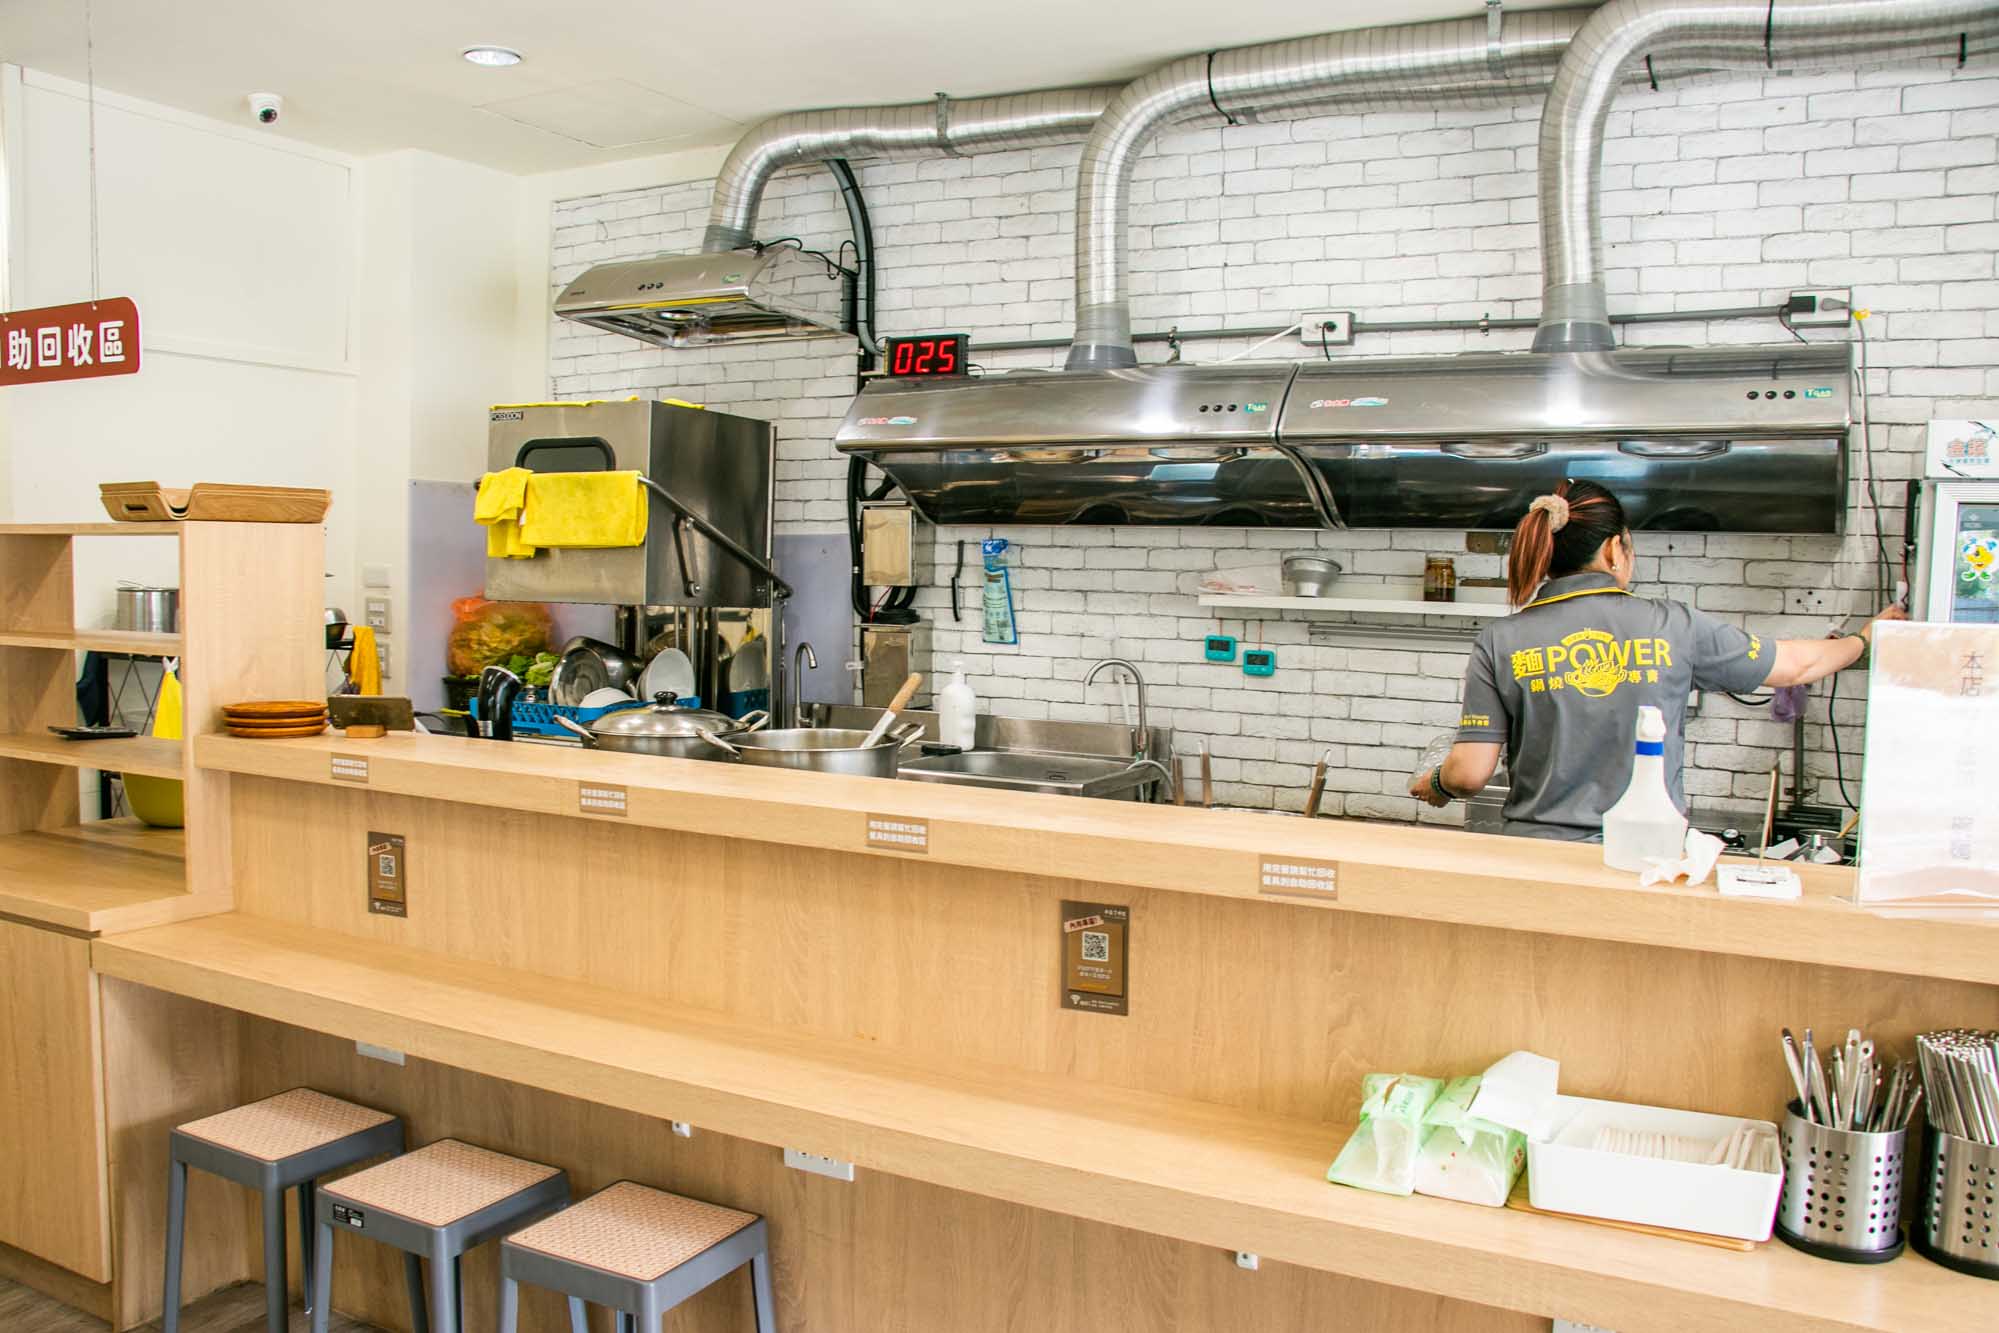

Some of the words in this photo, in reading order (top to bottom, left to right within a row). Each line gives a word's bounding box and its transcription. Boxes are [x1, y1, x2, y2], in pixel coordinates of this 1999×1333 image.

[0, 321, 125, 370] 助回收區
[894, 340, 956, 375] 025
